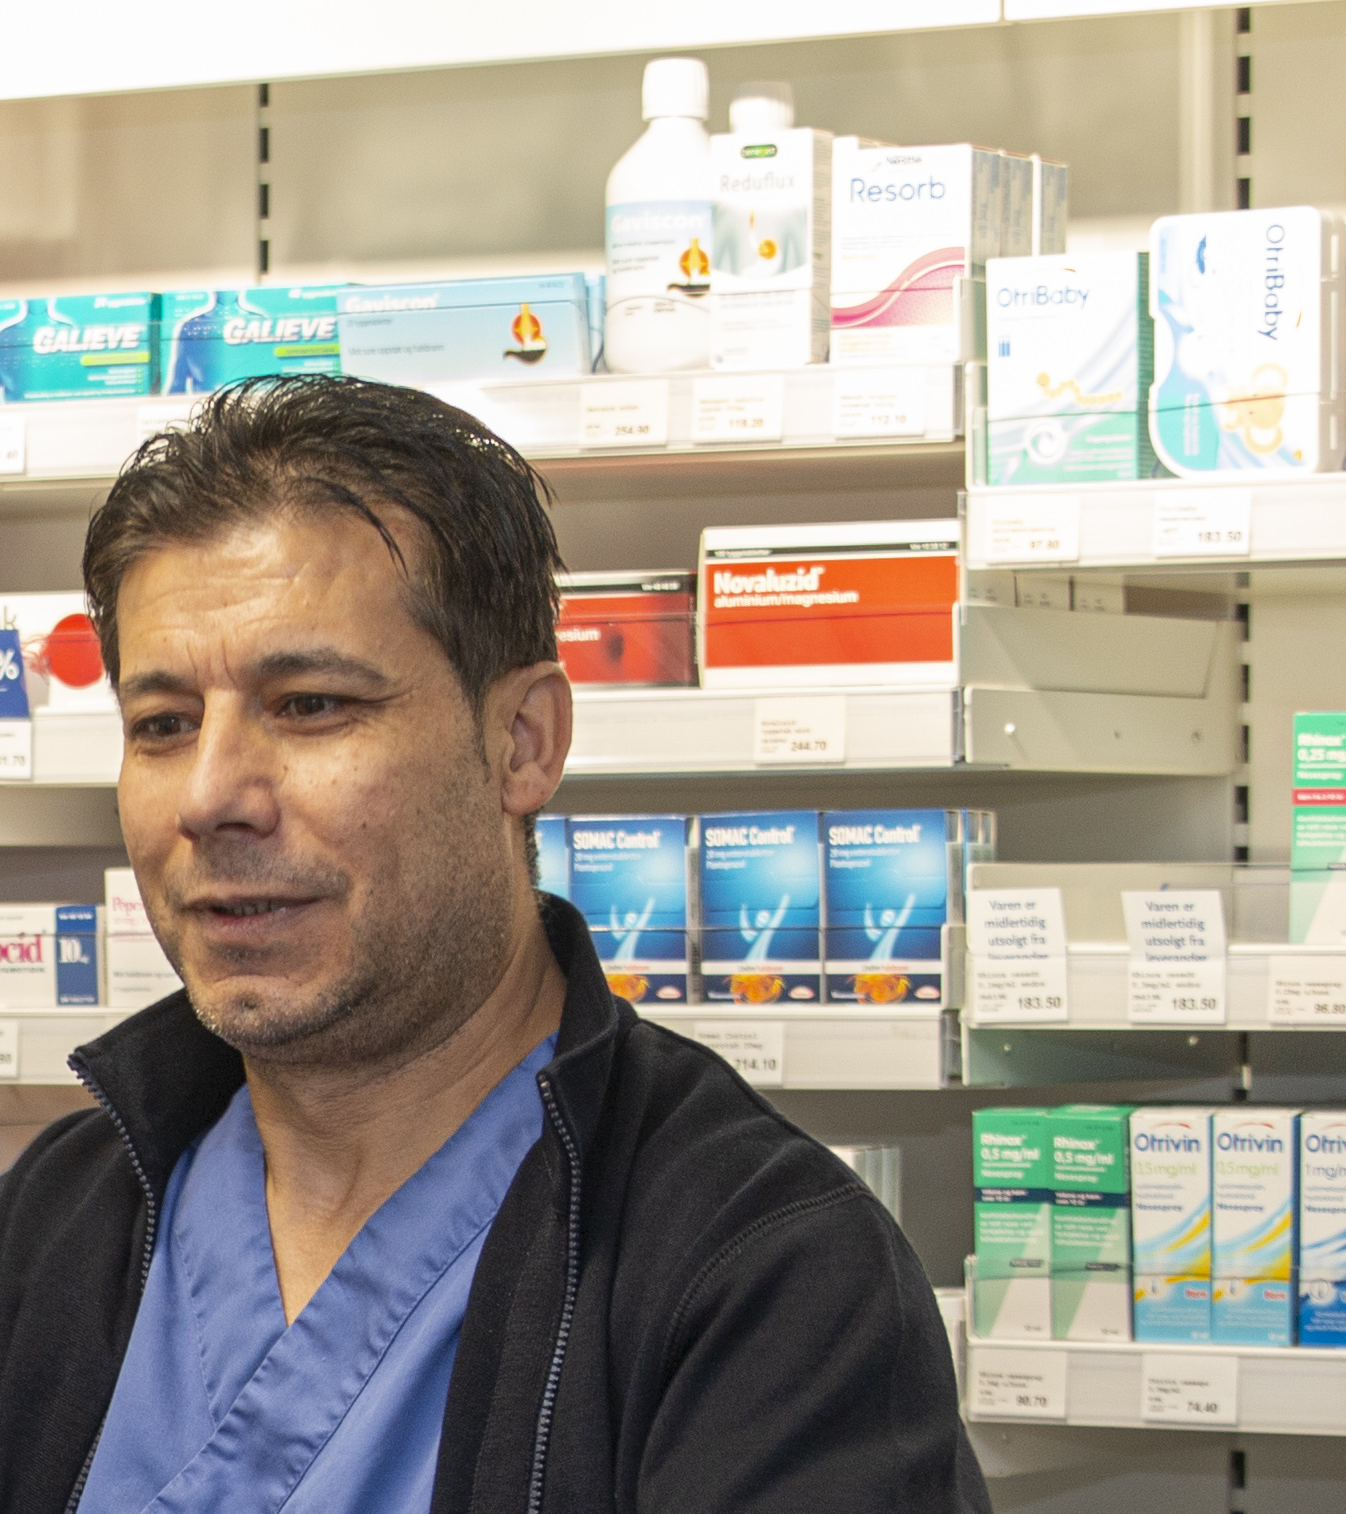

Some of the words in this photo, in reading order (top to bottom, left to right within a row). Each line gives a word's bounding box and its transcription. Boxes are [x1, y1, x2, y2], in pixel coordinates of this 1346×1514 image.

[719, 168, 796, 196] Reduflux
[848, 174, 948, 206] Resorb
[1256, 222, 1286, 343] OtriBaby
[995, 283, 1090, 311] OtriBaby
[33, 323, 142, 355] GALIEVE
[223, 316, 336, 347] GALIEVE
[712, 566, 825, 596] Novaluzid
[572, 830, 616, 850] SOMAC
[616, 830, 661, 849] Control
[705, 827, 748, 847] SOMAC
[749, 826, 794, 845] Control
[828, 827, 872, 847] SOMAC
[874, 825, 921, 844] Control
[989, 900, 1021, 911] Varen
[1025, 902, 1037, 911] er
[1146, 900, 1178, 912] Varen
[1184, 902, 1195, 911] er
[984, 917, 1047, 930] midlertidig
[1141, 918, 1205, 931] midlertidig
[988, 934, 1027, 949] utsolgt
[1030, 934, 1047, 945] fra
[1145, 934, 1184, 949] utsolgt
[1185, 934, 1205, 946] fra
[980, 1131, 1028, 1147] Rhinox
[1053, 1135, 1101, 1151] Rhinox
[1133, 1132, 1201, 1153] Otrivin
[1216, 1132, 1285, 1154] Otrivin
